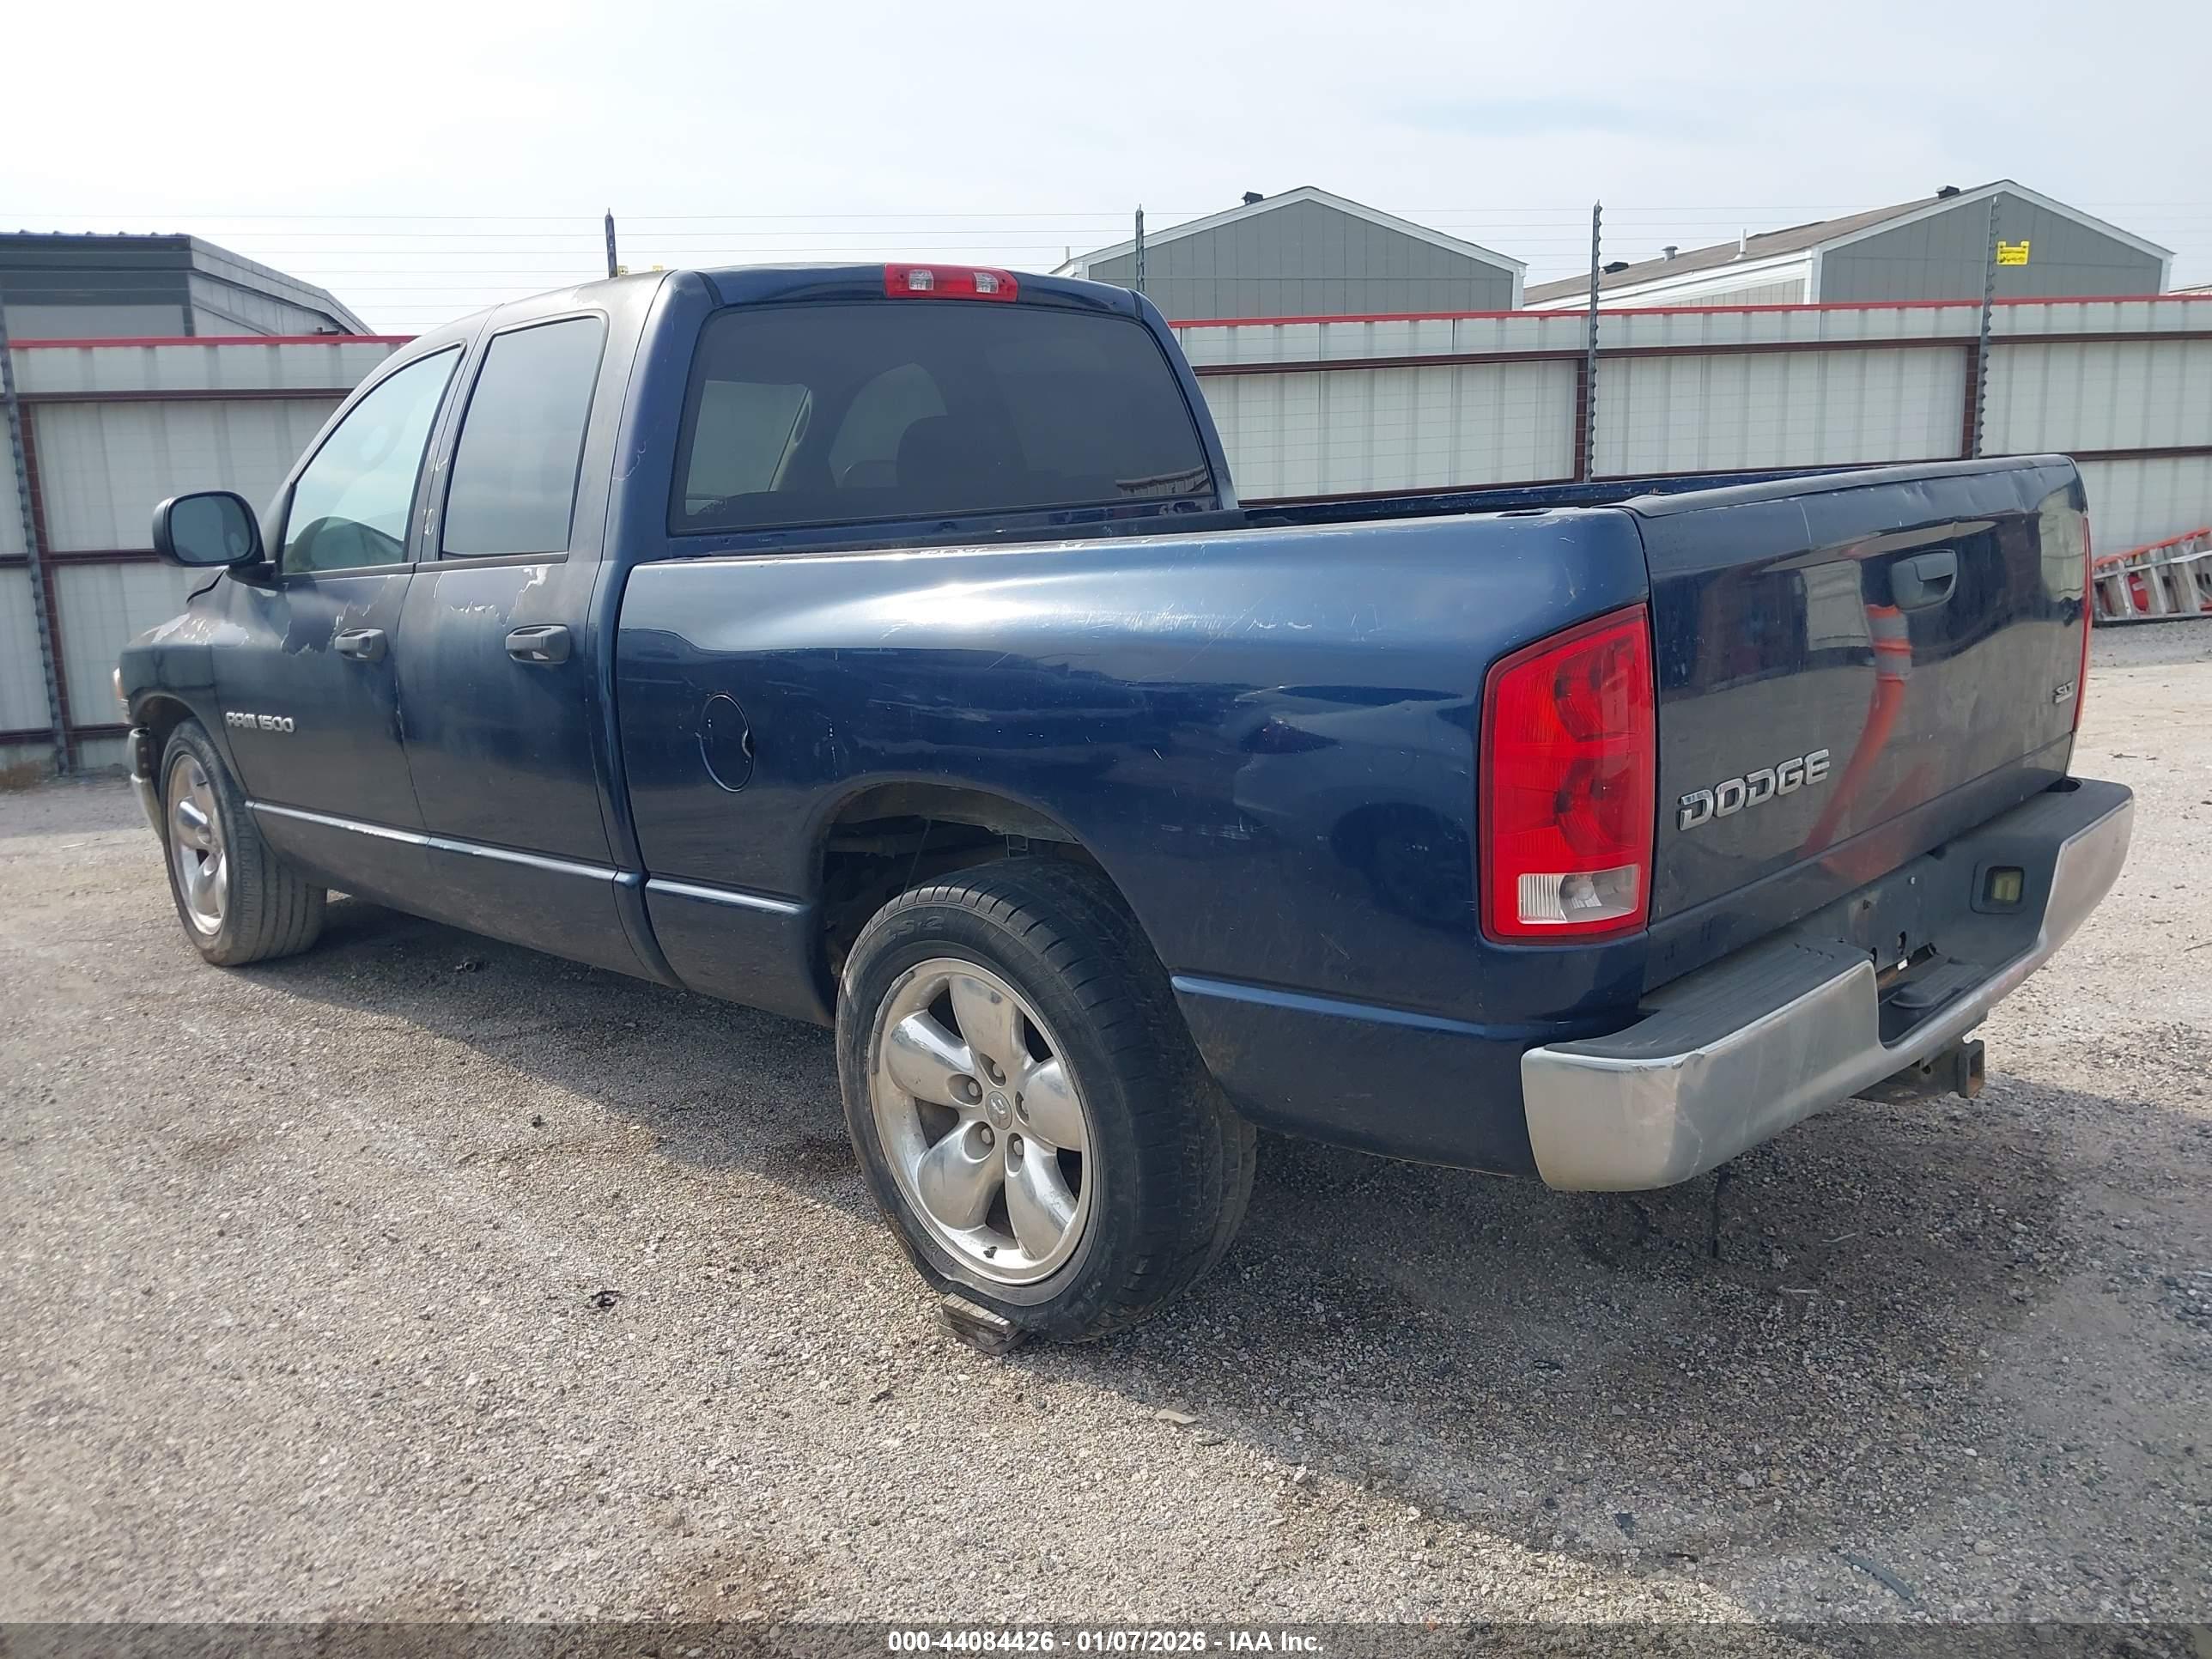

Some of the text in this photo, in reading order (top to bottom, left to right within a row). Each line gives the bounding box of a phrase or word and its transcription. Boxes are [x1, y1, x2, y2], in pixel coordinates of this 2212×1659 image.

[225, 712, 295, 733] RAM 1500
[1678, 748, 1831, 831] DODGE
